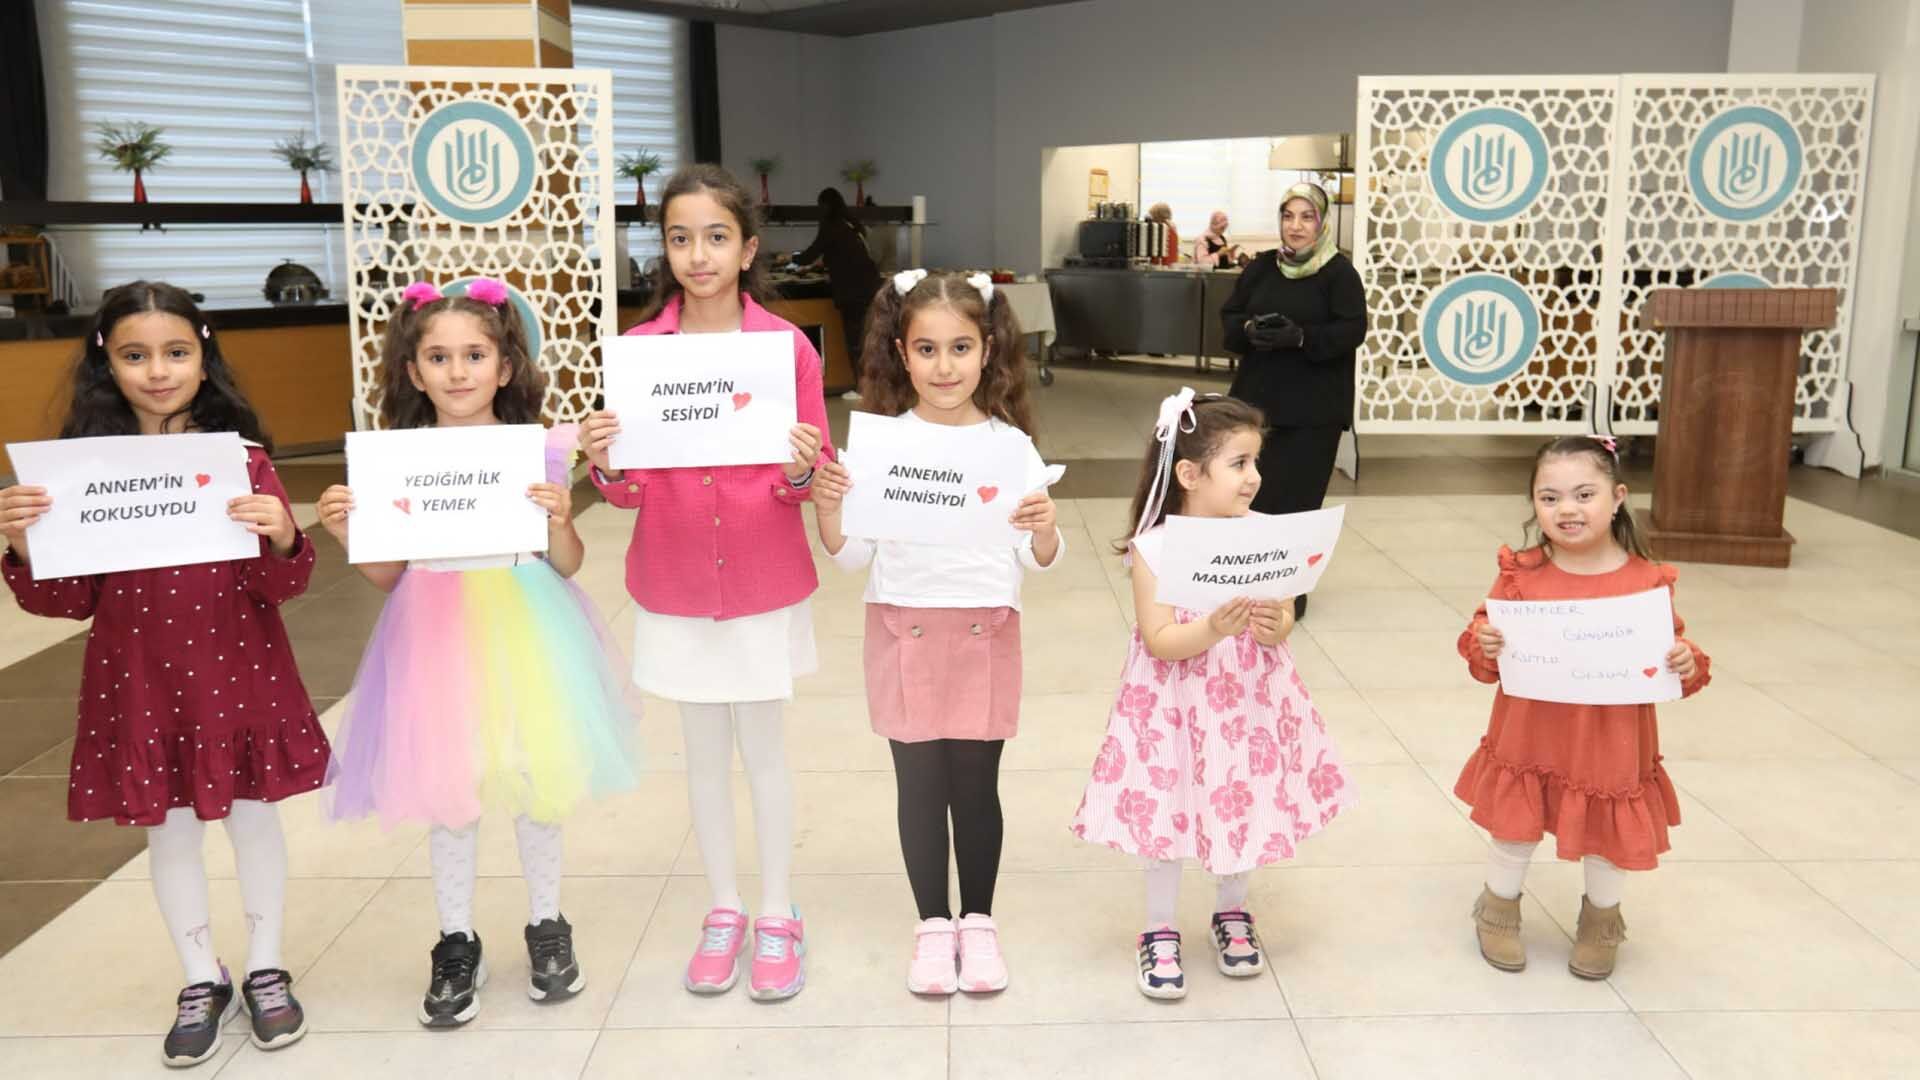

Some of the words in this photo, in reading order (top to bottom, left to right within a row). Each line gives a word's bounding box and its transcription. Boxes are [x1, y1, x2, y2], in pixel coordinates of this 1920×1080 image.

[661, 403, 720, 423] SESİYDİ
[405, 470, 472, 489] YEDİĞİM
[477, 469, 501, 486] İLK
[887, 464, 964, 485] ANNEMİN
[422, 498, 477, 512] YEMEK
[883, 486, 967, 508] NİNNİSİYDİ
[80, 500, 197, 524] KOKUSUYDU
